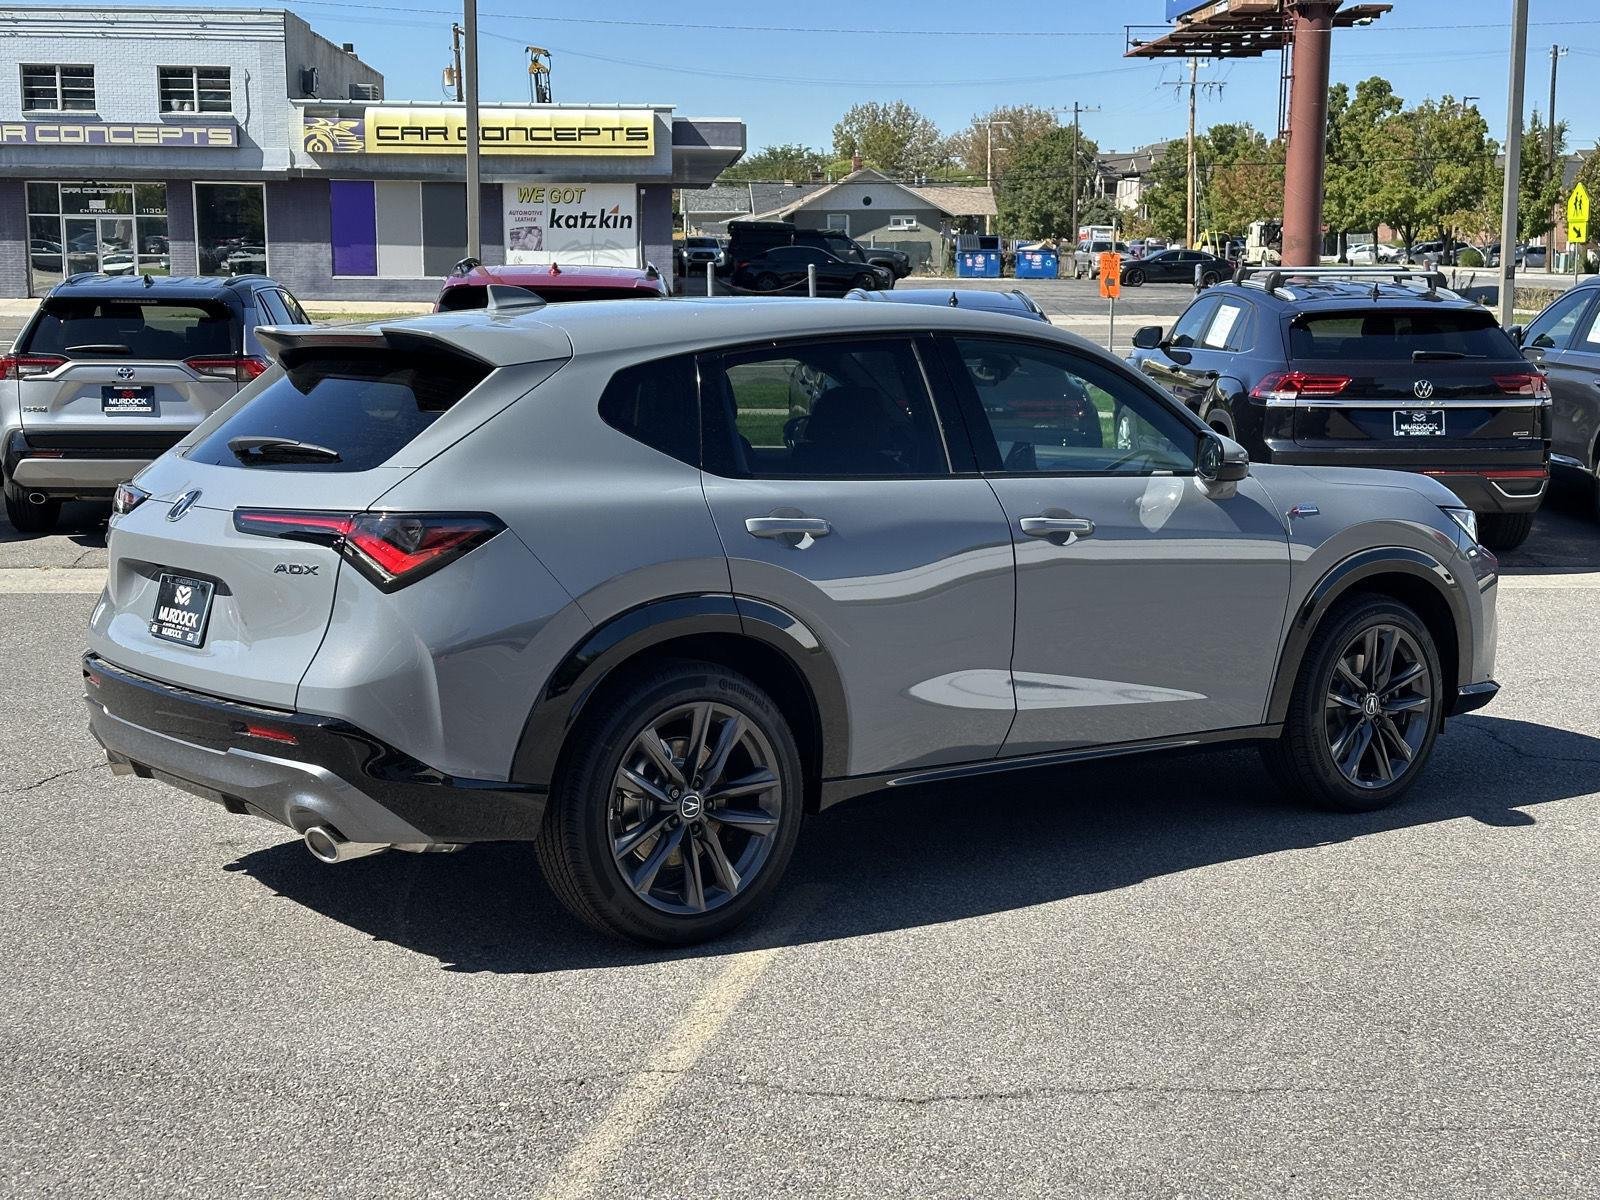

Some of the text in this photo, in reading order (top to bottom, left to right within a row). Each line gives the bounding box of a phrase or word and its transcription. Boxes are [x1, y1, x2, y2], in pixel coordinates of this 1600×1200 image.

[0, 125, 233, 145] R CONCEPTS
[376, 125, 449, 141] CAR
[517, 187, 586, 204] WE GOT
[549, 205, 633, 228] katzkin
[274, 564, 319, 576] ADX
[158, 605, 199, 629] MURDOCK
